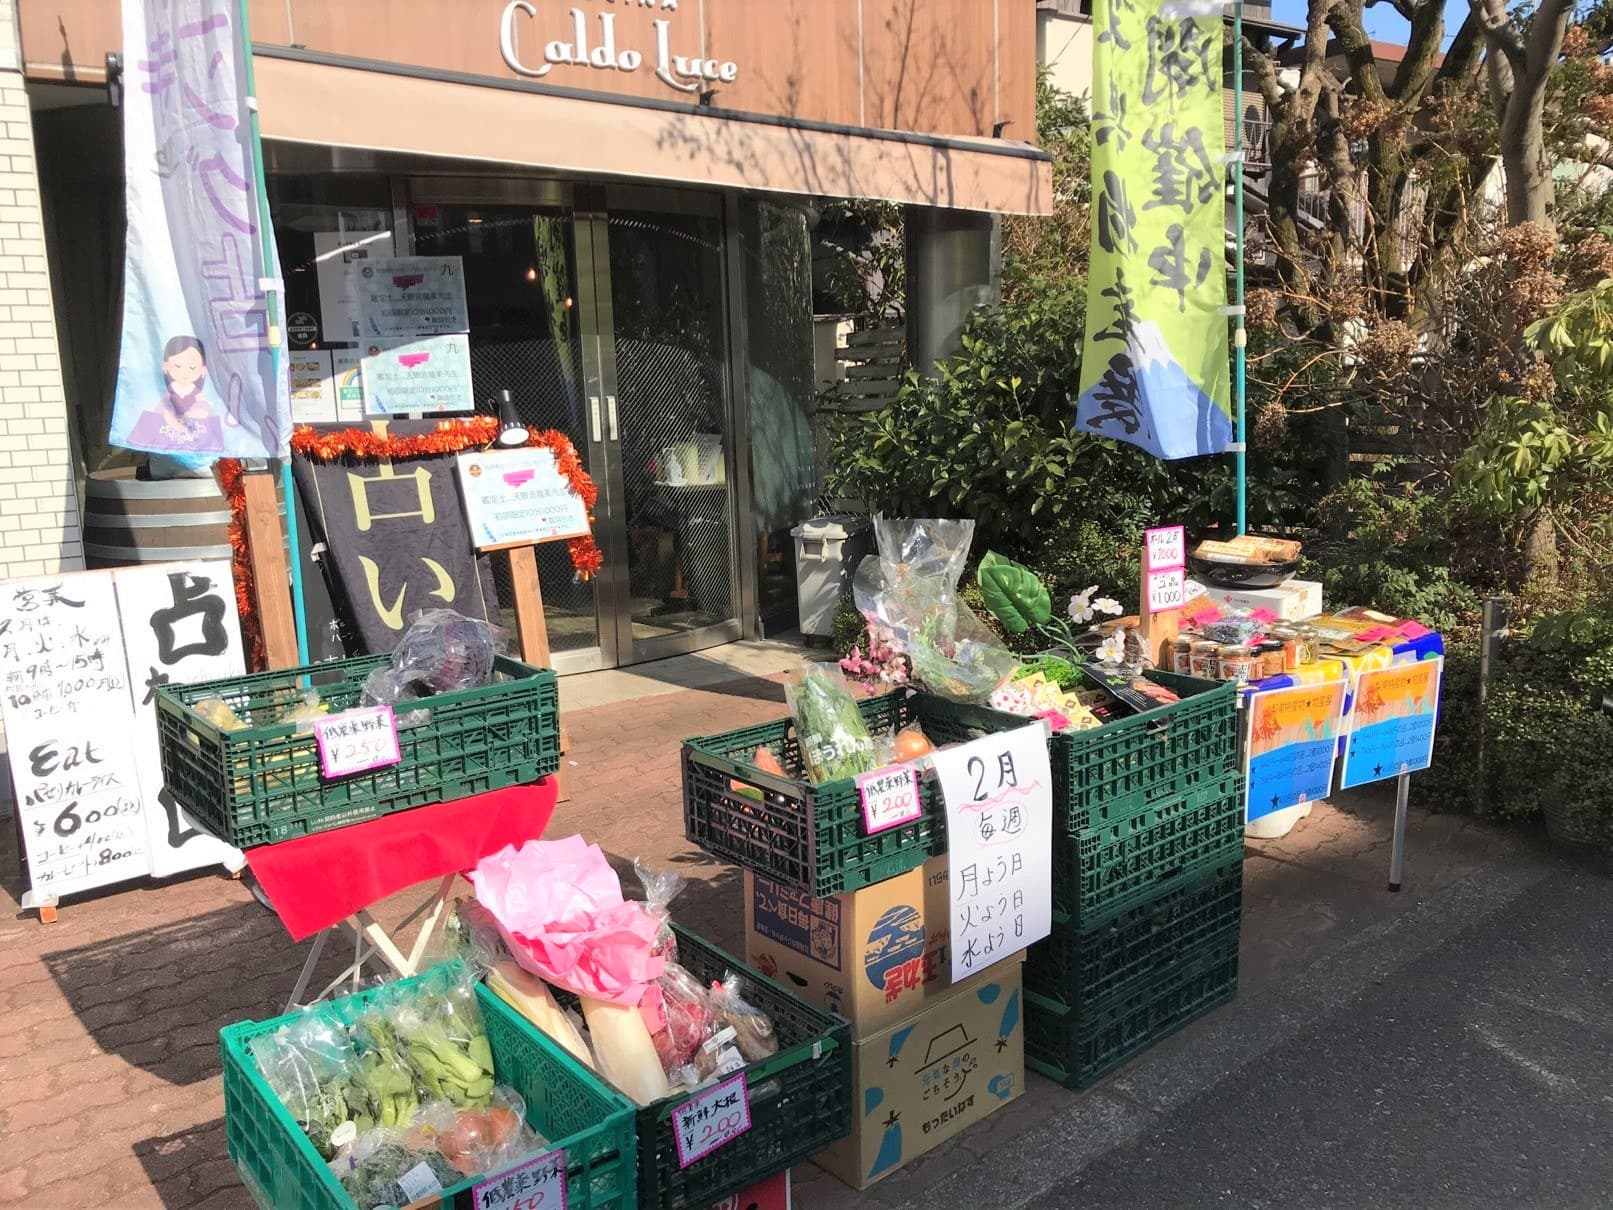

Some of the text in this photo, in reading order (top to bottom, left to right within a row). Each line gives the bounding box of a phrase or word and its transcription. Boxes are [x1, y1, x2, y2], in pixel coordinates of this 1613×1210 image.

[500, 0, 738, 91] Caldo Luce
[29, 738, 104, 778] Eat
[967, 750, 1018, 801] 2月
[980, 805, 1022, 841] 毎週
[957, 852, 1023, 901] 月よう日
[960, 889, 1024, 936] 火よう日
[961, 914, 1024, 968] 水よう日
[681, 1091, 741, 1130] 新鮮大根
